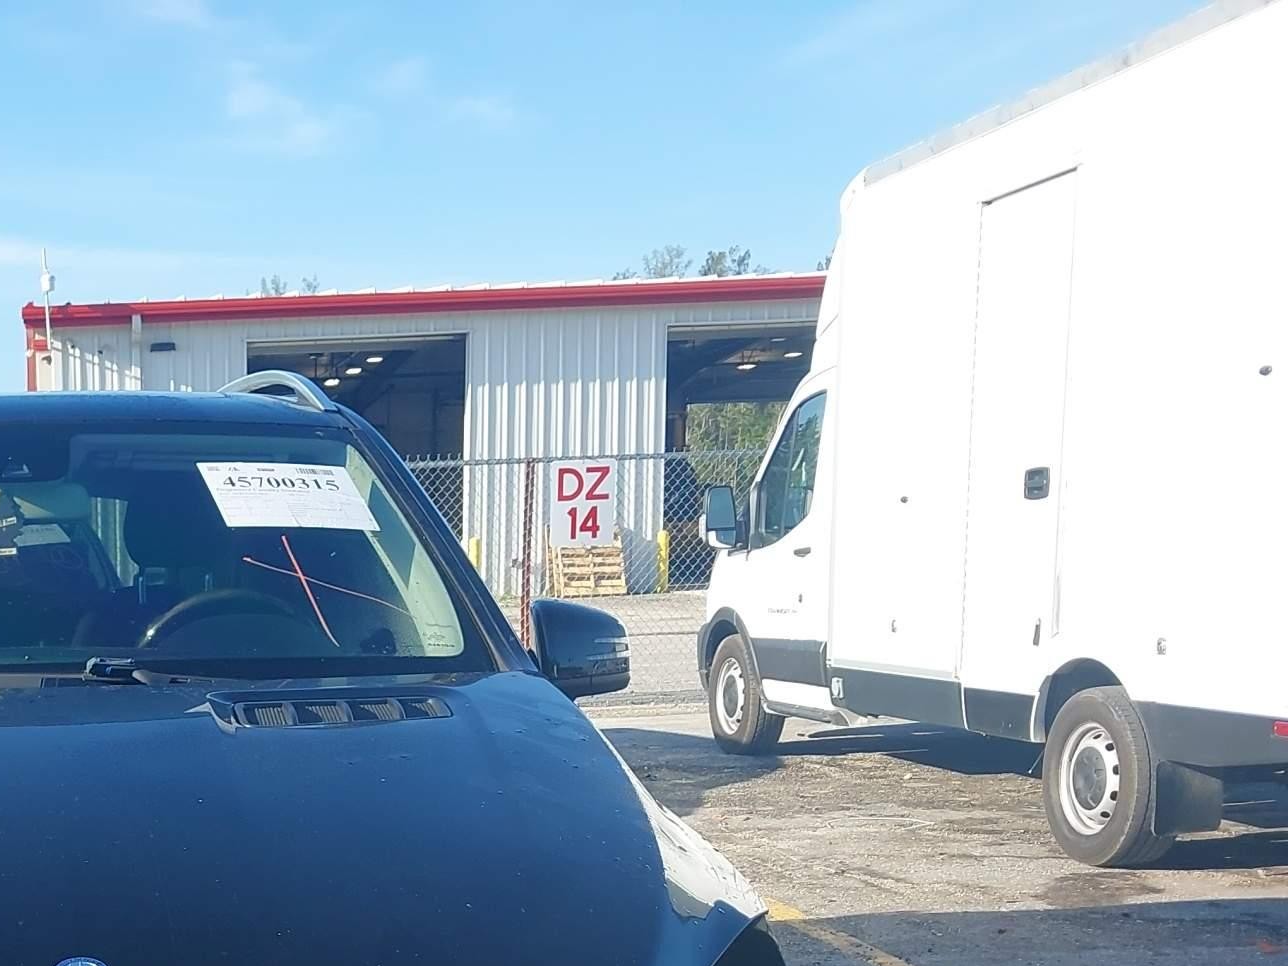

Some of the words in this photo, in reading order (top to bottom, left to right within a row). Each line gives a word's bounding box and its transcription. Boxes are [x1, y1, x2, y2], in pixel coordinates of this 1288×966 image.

[223, 475, 340, 491] 45700315
[557, 466, 610, 502] DZ
[567, 506, 600, 540] 14
